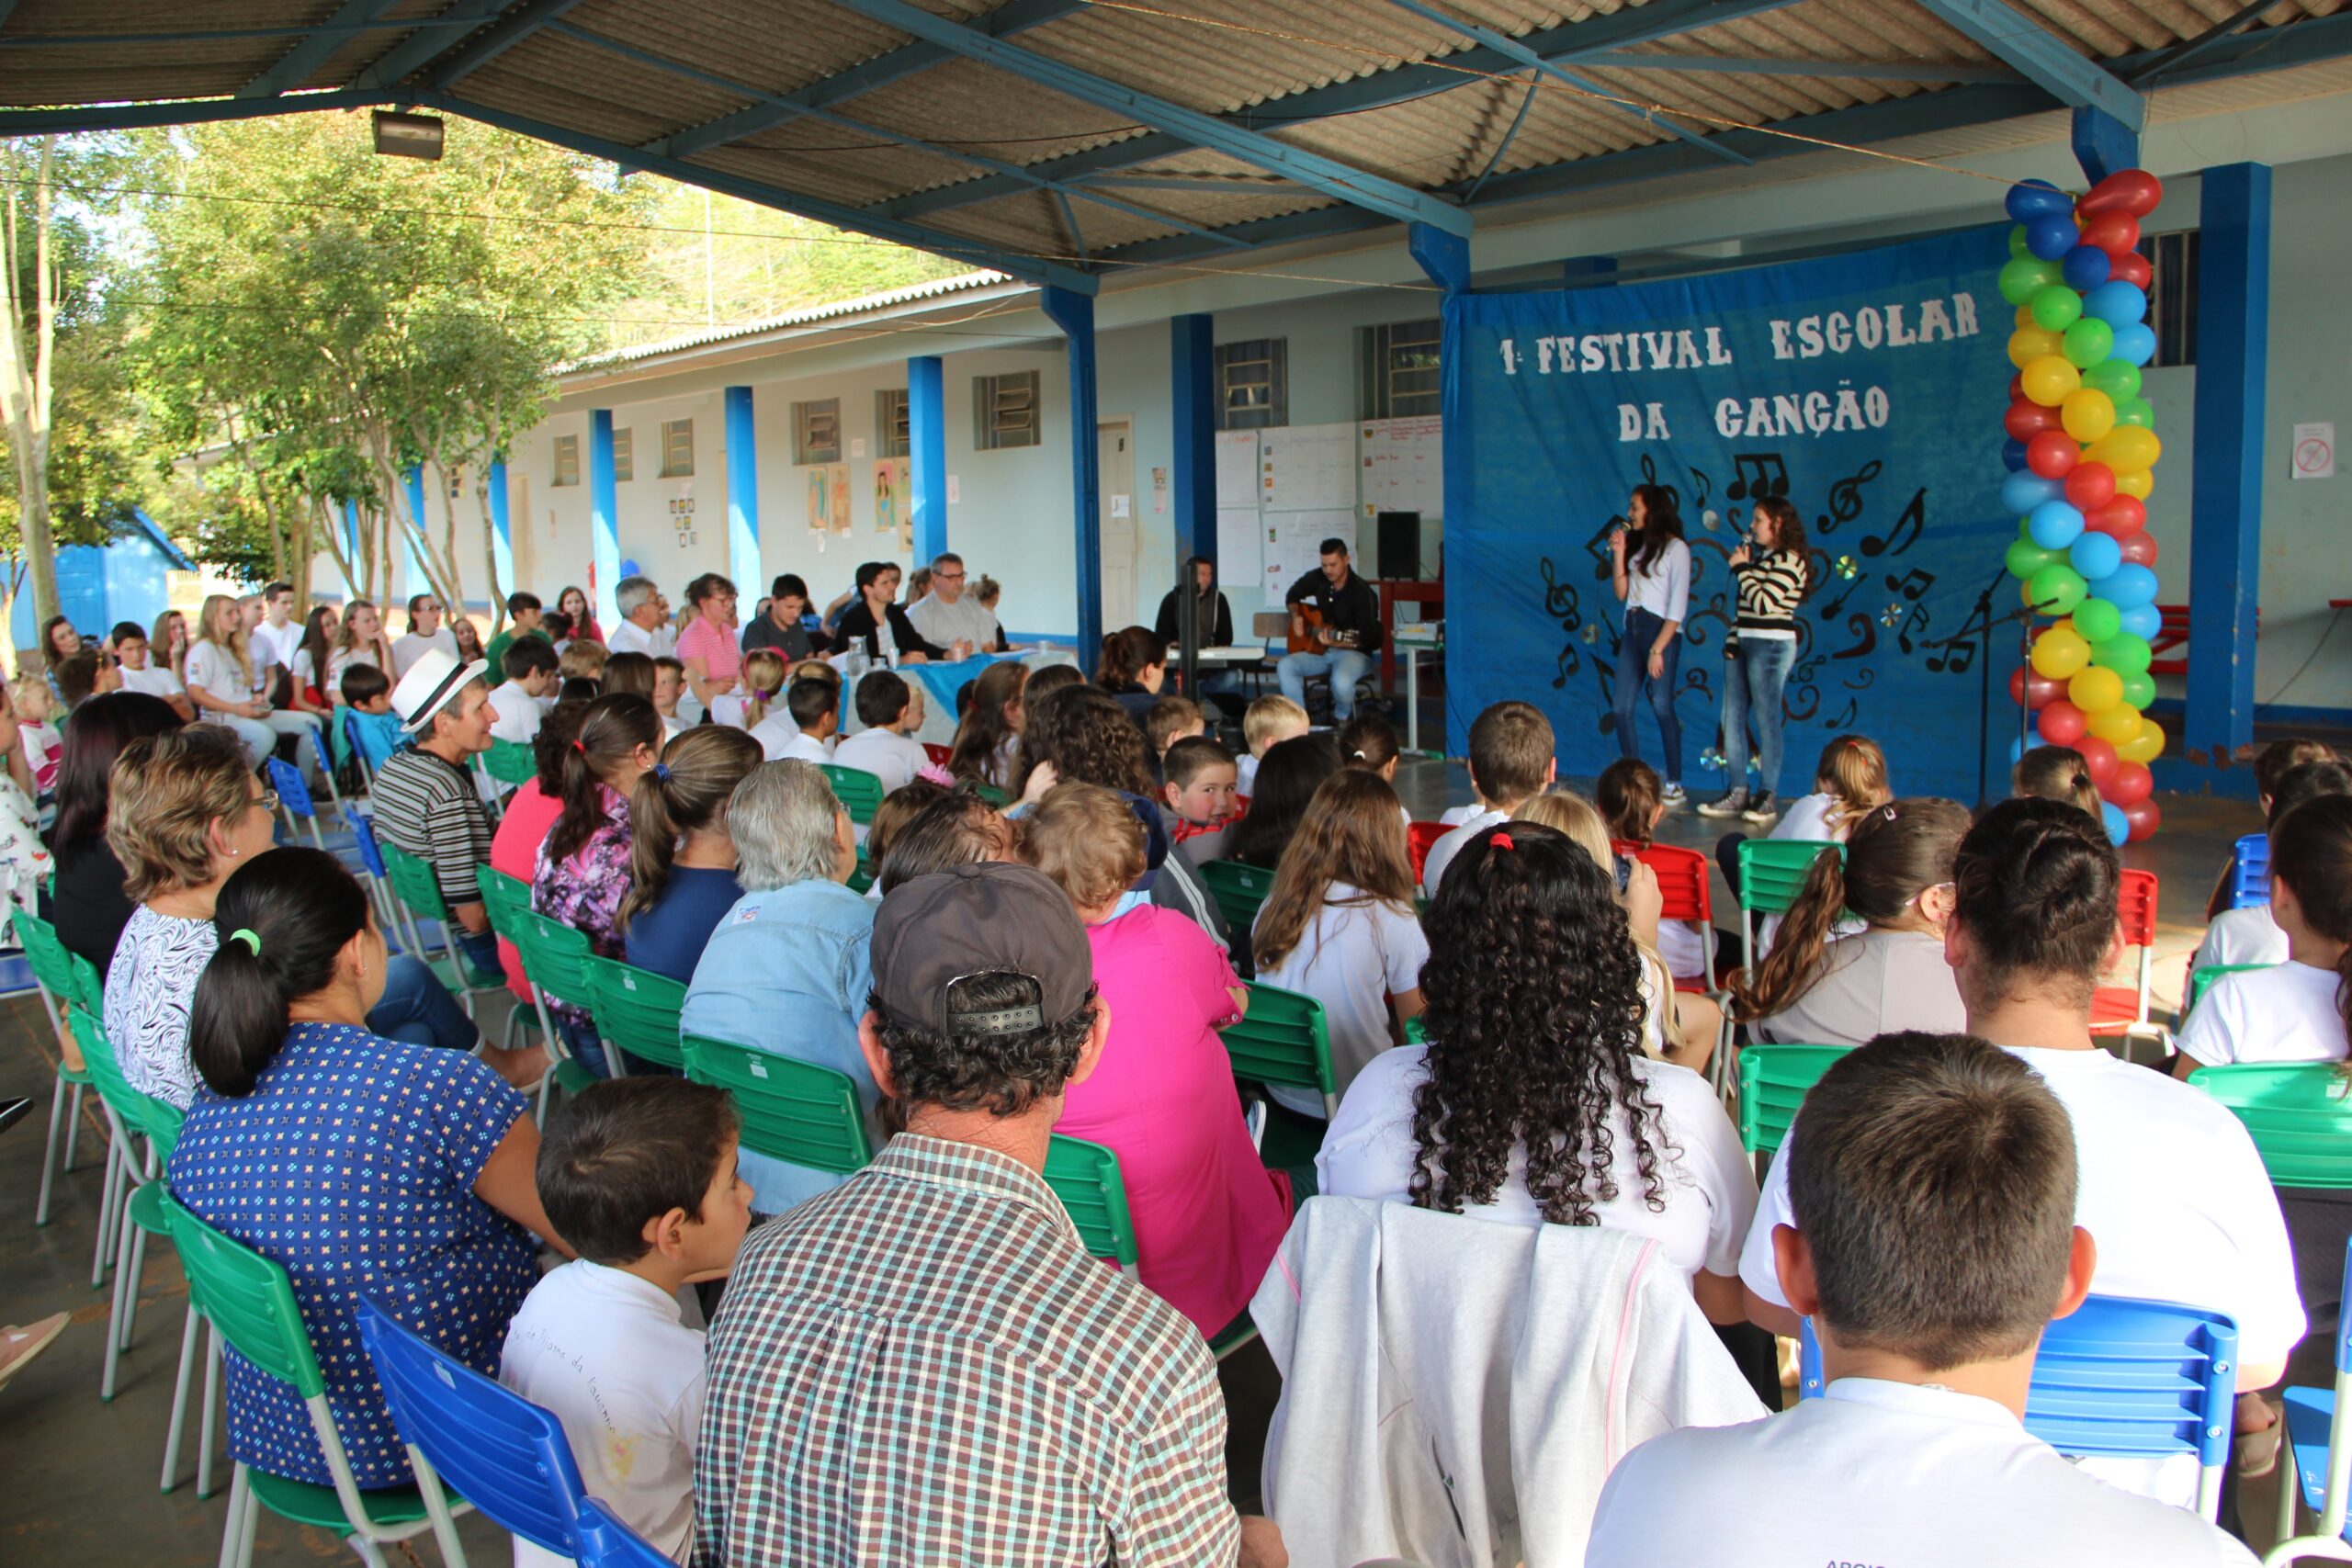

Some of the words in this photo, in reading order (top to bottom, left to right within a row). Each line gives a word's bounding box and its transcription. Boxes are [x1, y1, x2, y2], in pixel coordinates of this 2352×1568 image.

[1535, 326, 1733, 374] FESTIVAL
[1770, 292, 1979, 360] ESCOLAR
[1617, 402, 1671, 442] DA
